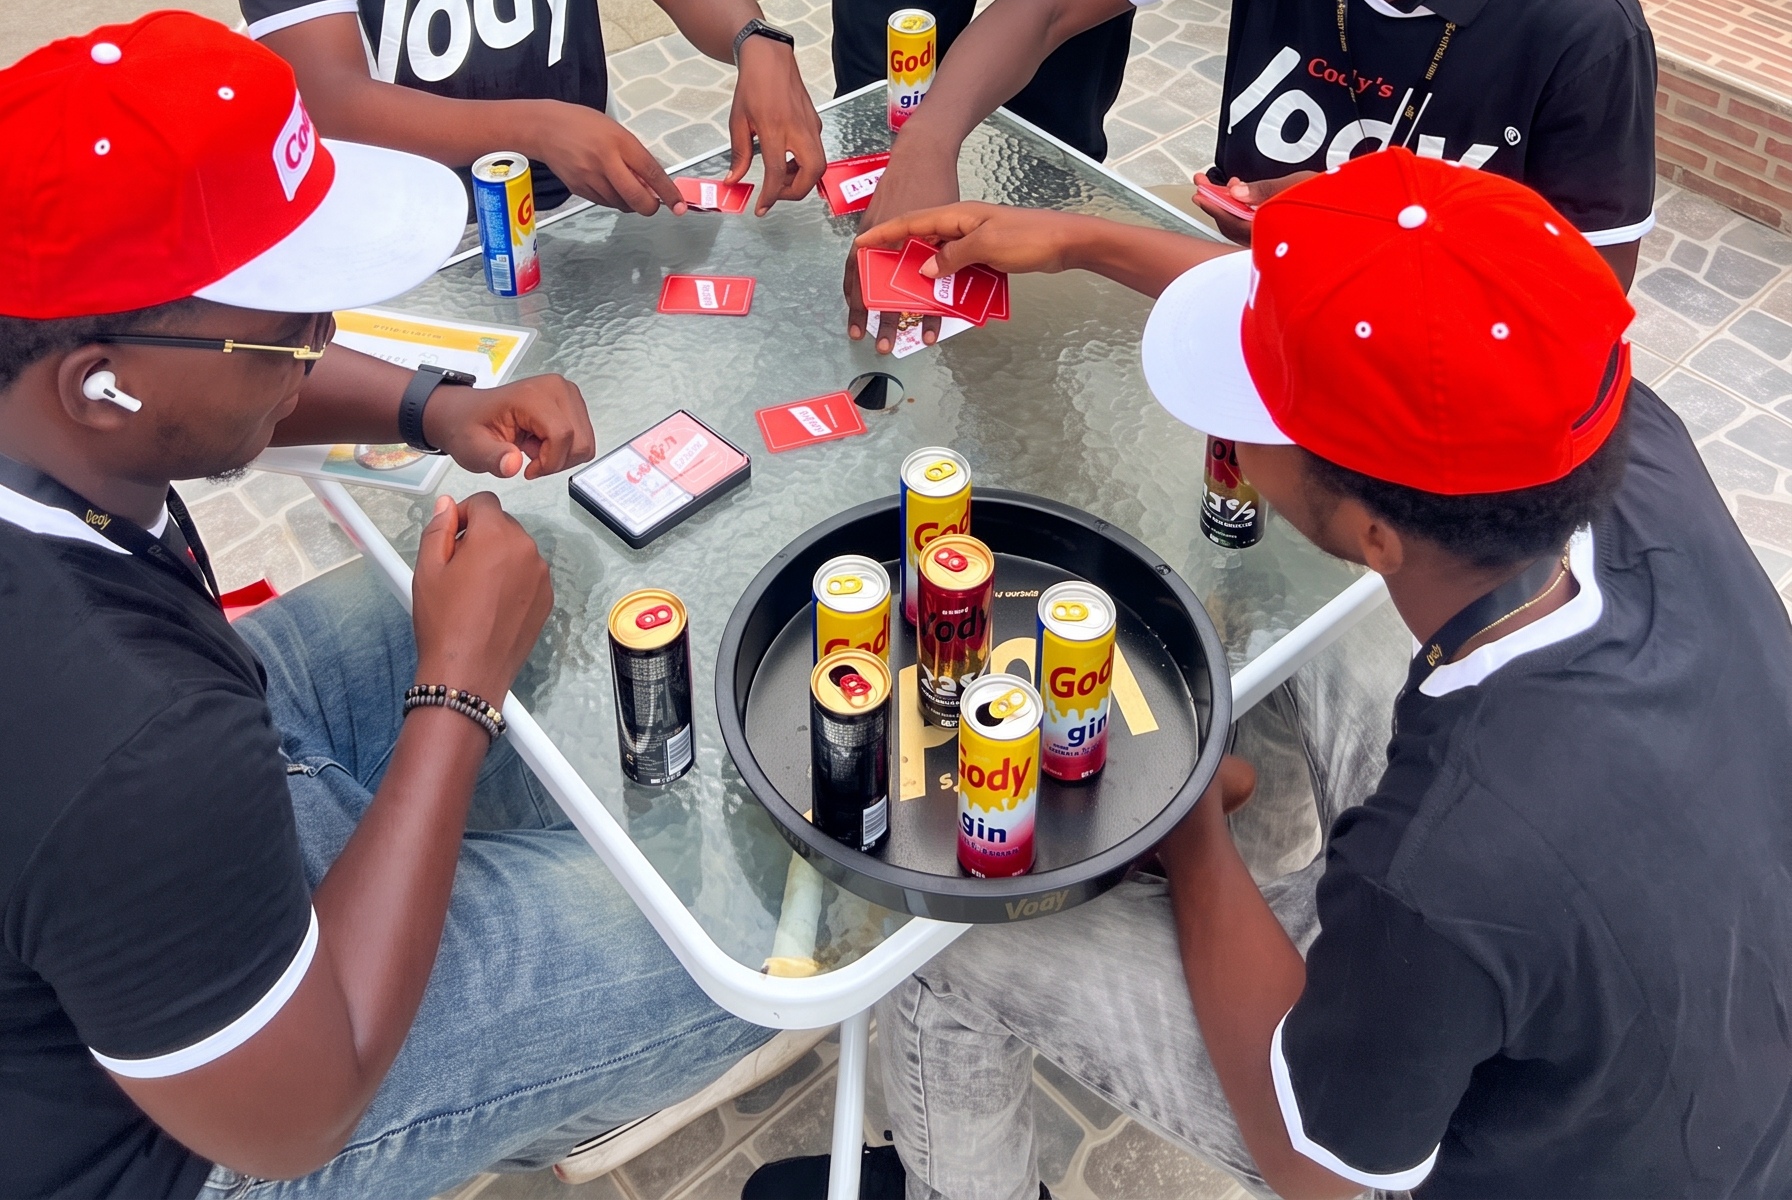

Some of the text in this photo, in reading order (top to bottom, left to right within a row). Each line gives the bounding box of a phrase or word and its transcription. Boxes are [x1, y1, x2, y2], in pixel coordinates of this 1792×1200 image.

[890, 40, 935, 74] God
[1049, 642, 1114, 699] God
[961, 811, 1008, 844] gin
